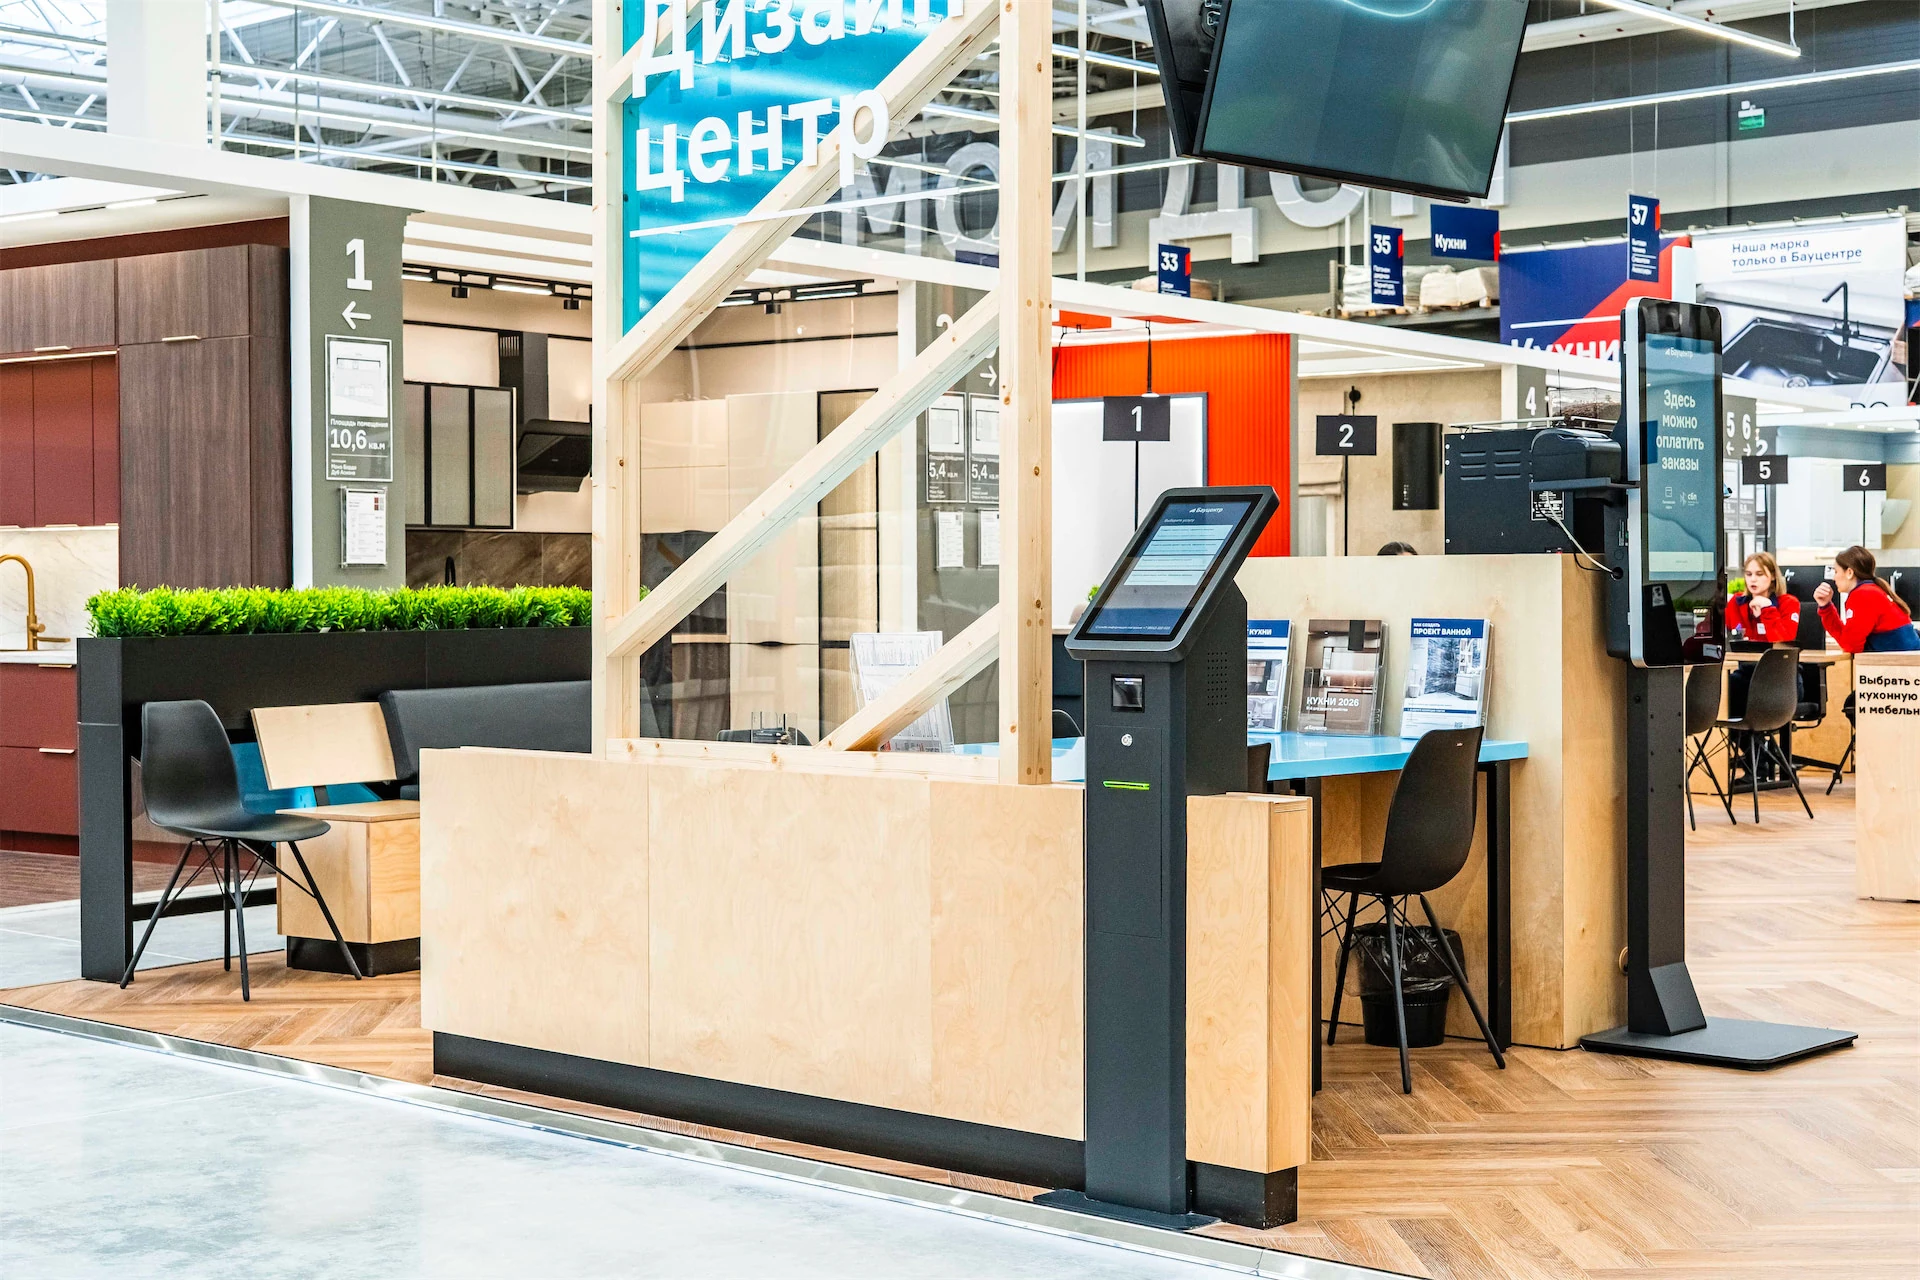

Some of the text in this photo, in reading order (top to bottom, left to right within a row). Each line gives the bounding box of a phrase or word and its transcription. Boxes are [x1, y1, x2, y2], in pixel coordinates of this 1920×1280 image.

[636, 89, 889, 203] центр
[1631, 203, 1648, 226] 37
[1373, 233, 1392, 255] 35
[1435, 233, 1467, 253] Кухни
[1732, 239, 1810, 253] Наша марка
[346, 238, 372, 290] 1
[1160, 251, 1179, 272] 33
[1732, 248, 1862, 267] только в Бауцентре
[1670, 347, 1694, 359] Бауцентр
[1525, 386, 1537, 416] 4
[1663, 389, 1696, 410] Здесь
[331, 418, 356, 427] Площадь
[1130, 405, 1143, 433] 1
[1662, 414, 1698, 429] можно
[1726, 411, 1751, 440] 5 6
[331, 428, 385, 451] 10,6 кв.м
[1338, 423, 1355, 448] 2
[1656, 434, 1705, 451] оплатить
[929, 462, 945, 479] 5,4
[972, 464, 987, 480] 5,4
[1661, 456, 1699, 471] заказы
[1759, 460, 1772, 480] 5
[1858, 468, 1871, 487] 6
[1249, 628, 1273, 636] КУХНИ
[1413, 627, 1472, 636] ПРОЕКТ ВАННОЙ
[1859, 675, 1911, 688] Выбрать
[1306, 696, 1360, 707] КУХНИ 2026
[1859, 692, 1918, 703] кухонную
[1859, 704, 1920, 715] и мебельн
